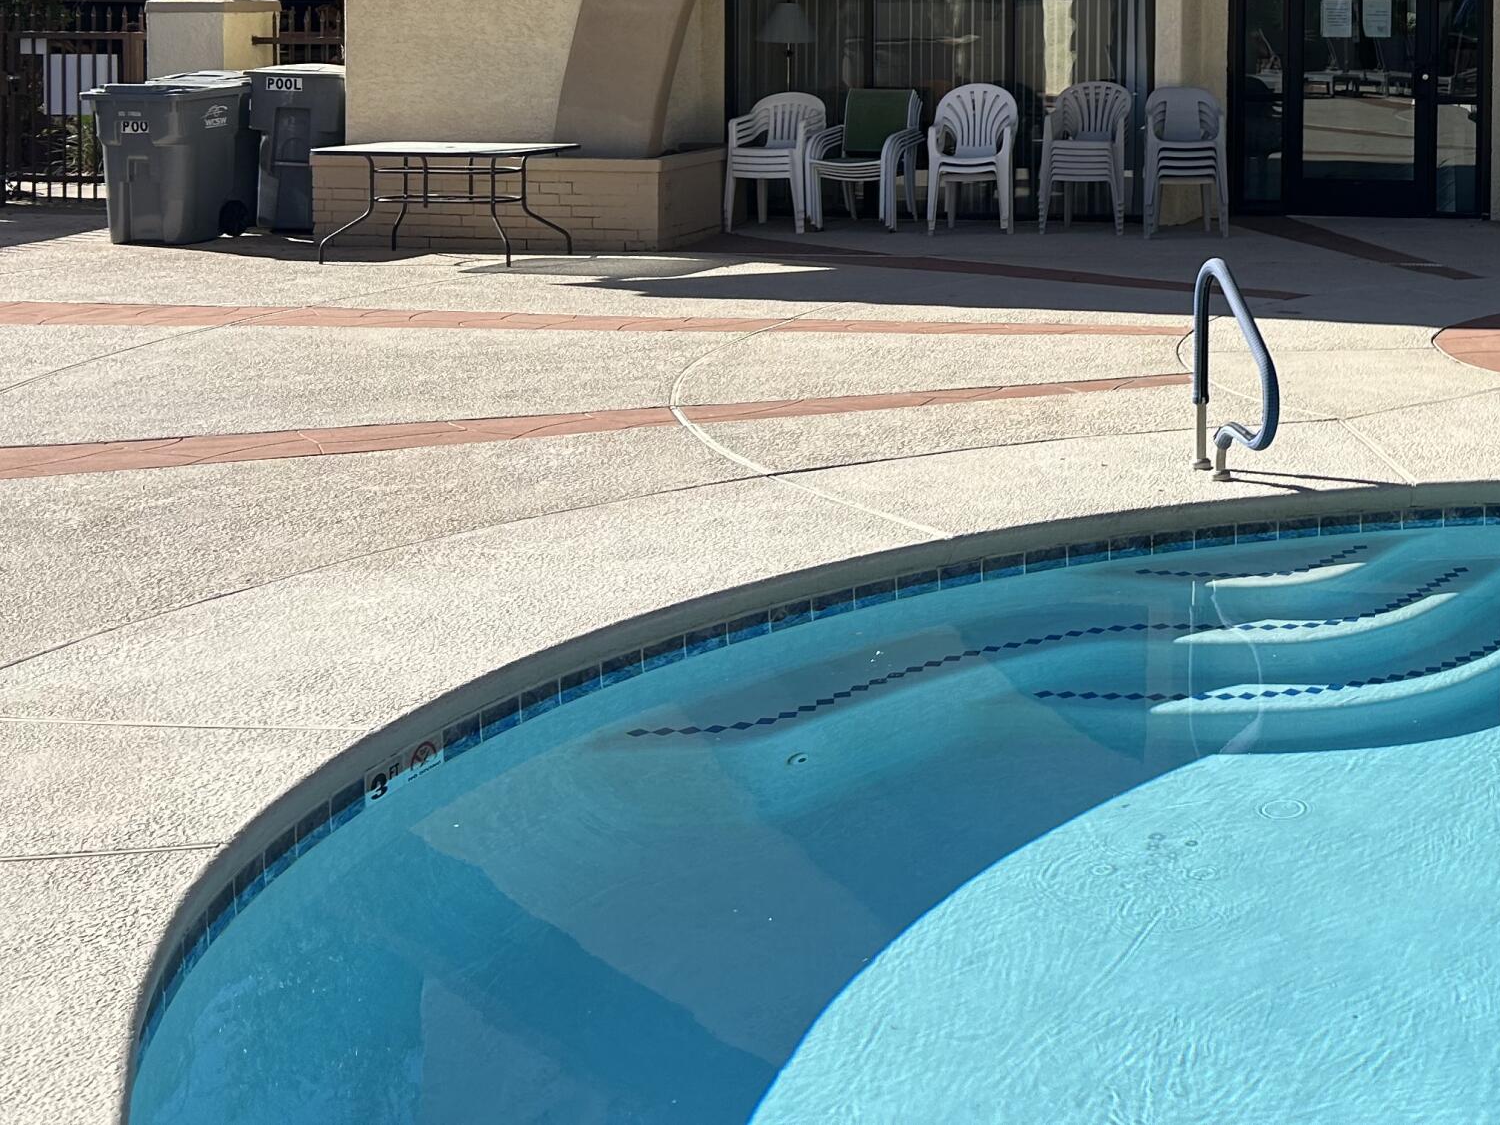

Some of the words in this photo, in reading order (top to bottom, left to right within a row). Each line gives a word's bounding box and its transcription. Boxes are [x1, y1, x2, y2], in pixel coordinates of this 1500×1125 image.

[268, 78, 301, 90] POOL
[204, 117, 227, 126] WCSW
[370, 772, 388, 800] 3
[389, 762, 400, 780] FT
